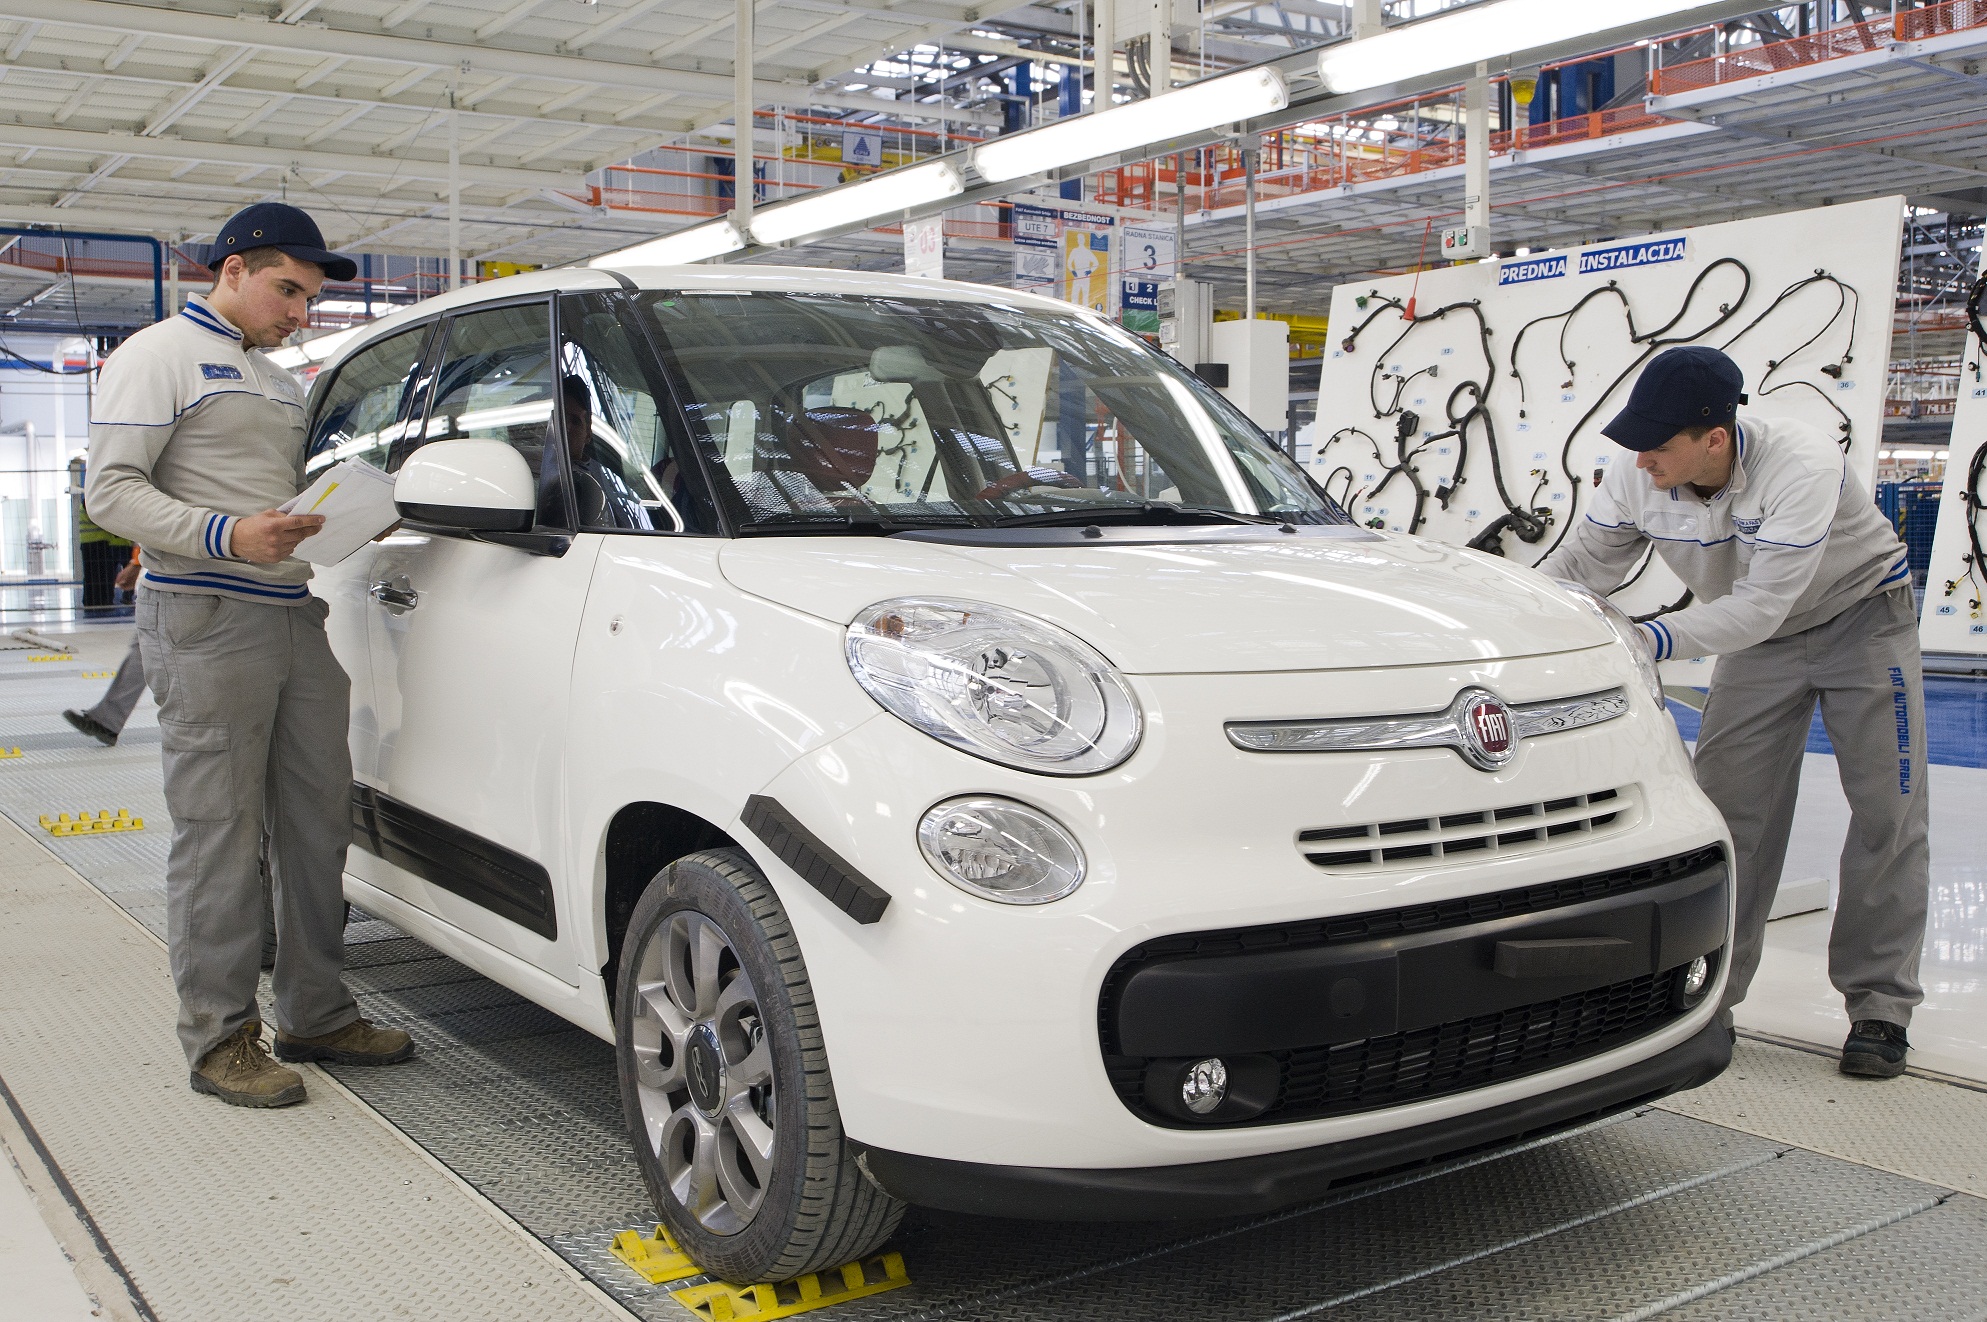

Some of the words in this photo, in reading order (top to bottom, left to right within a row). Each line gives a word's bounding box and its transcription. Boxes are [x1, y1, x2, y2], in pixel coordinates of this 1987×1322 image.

[1064, 212, 1110, 223] BEZBEDNOST
[1025, 222, 1041, 232] UTE
[1043, 224, 1048, 233] 7
[1125, 230, 1147, 239] RADNA
[1148, 233, 1174, 242] STANICA
[1143, 244, 1157, 271] 3
[1499, 259, 1566, 283] PREDNJA
[1580, 242, 1685, 271] INSTALACIJA
[1146, 284, 1153, 293] 2
[1129, 296, 1152, 305] CHECK
[1840, 381, 1849, 389] 36
[1975, 389, 1986, 397] 41
[1939, 606, 1951, 614] 45
[1972, 625, 1984, 633] 46
[1887, 666, 1905, 688] FIAT
[1478, 713, 1507, 743] FIAT
[1893, 691, 1910, 754] AUTOMOBILI
[1899, 758, 1911, 795] SRBIJA
